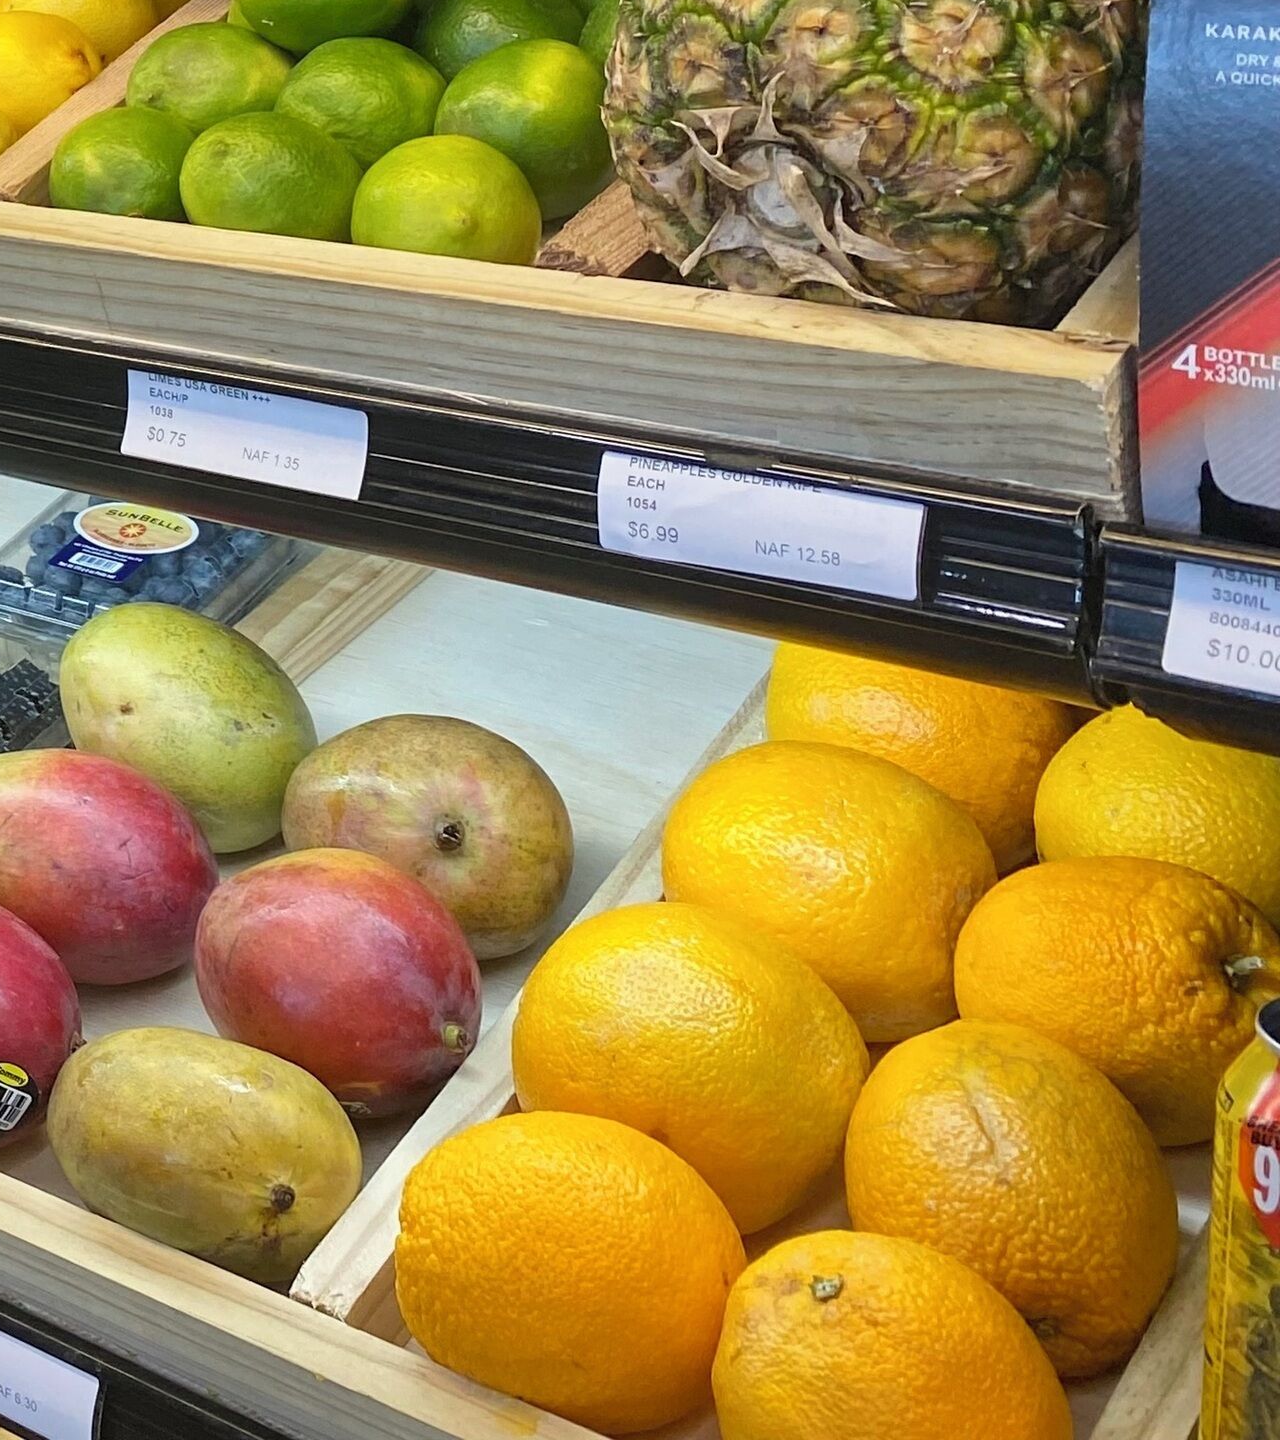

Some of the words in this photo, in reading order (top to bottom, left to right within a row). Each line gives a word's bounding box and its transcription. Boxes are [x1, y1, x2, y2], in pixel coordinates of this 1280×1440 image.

[1236, 53, 1269, 66] DRY
[1215, 71, 1227, 83] A
[1172, 344, 1201, 379] 4
[149, 387, 189, 403] EACH/P
[185, 379, 208, 392] USA
[209, 383, 250, 401] GREEN
[149, 405, 174, 419] 1038
[242, 446, 270, 464] NAF
[629, 455, 727, 482] PINEAPPLES
[627, 475, 666, 492] EACH
[626, 496, 658, 512] 1054
[627, 520, 680, 545] $6.99
[754, 539, 790, 558] NAF
[797, 546, 841, 567] 12.58
[1212, 588, 1271, 611] 330ML
[14, 1391, 39, 1413] 6.30
